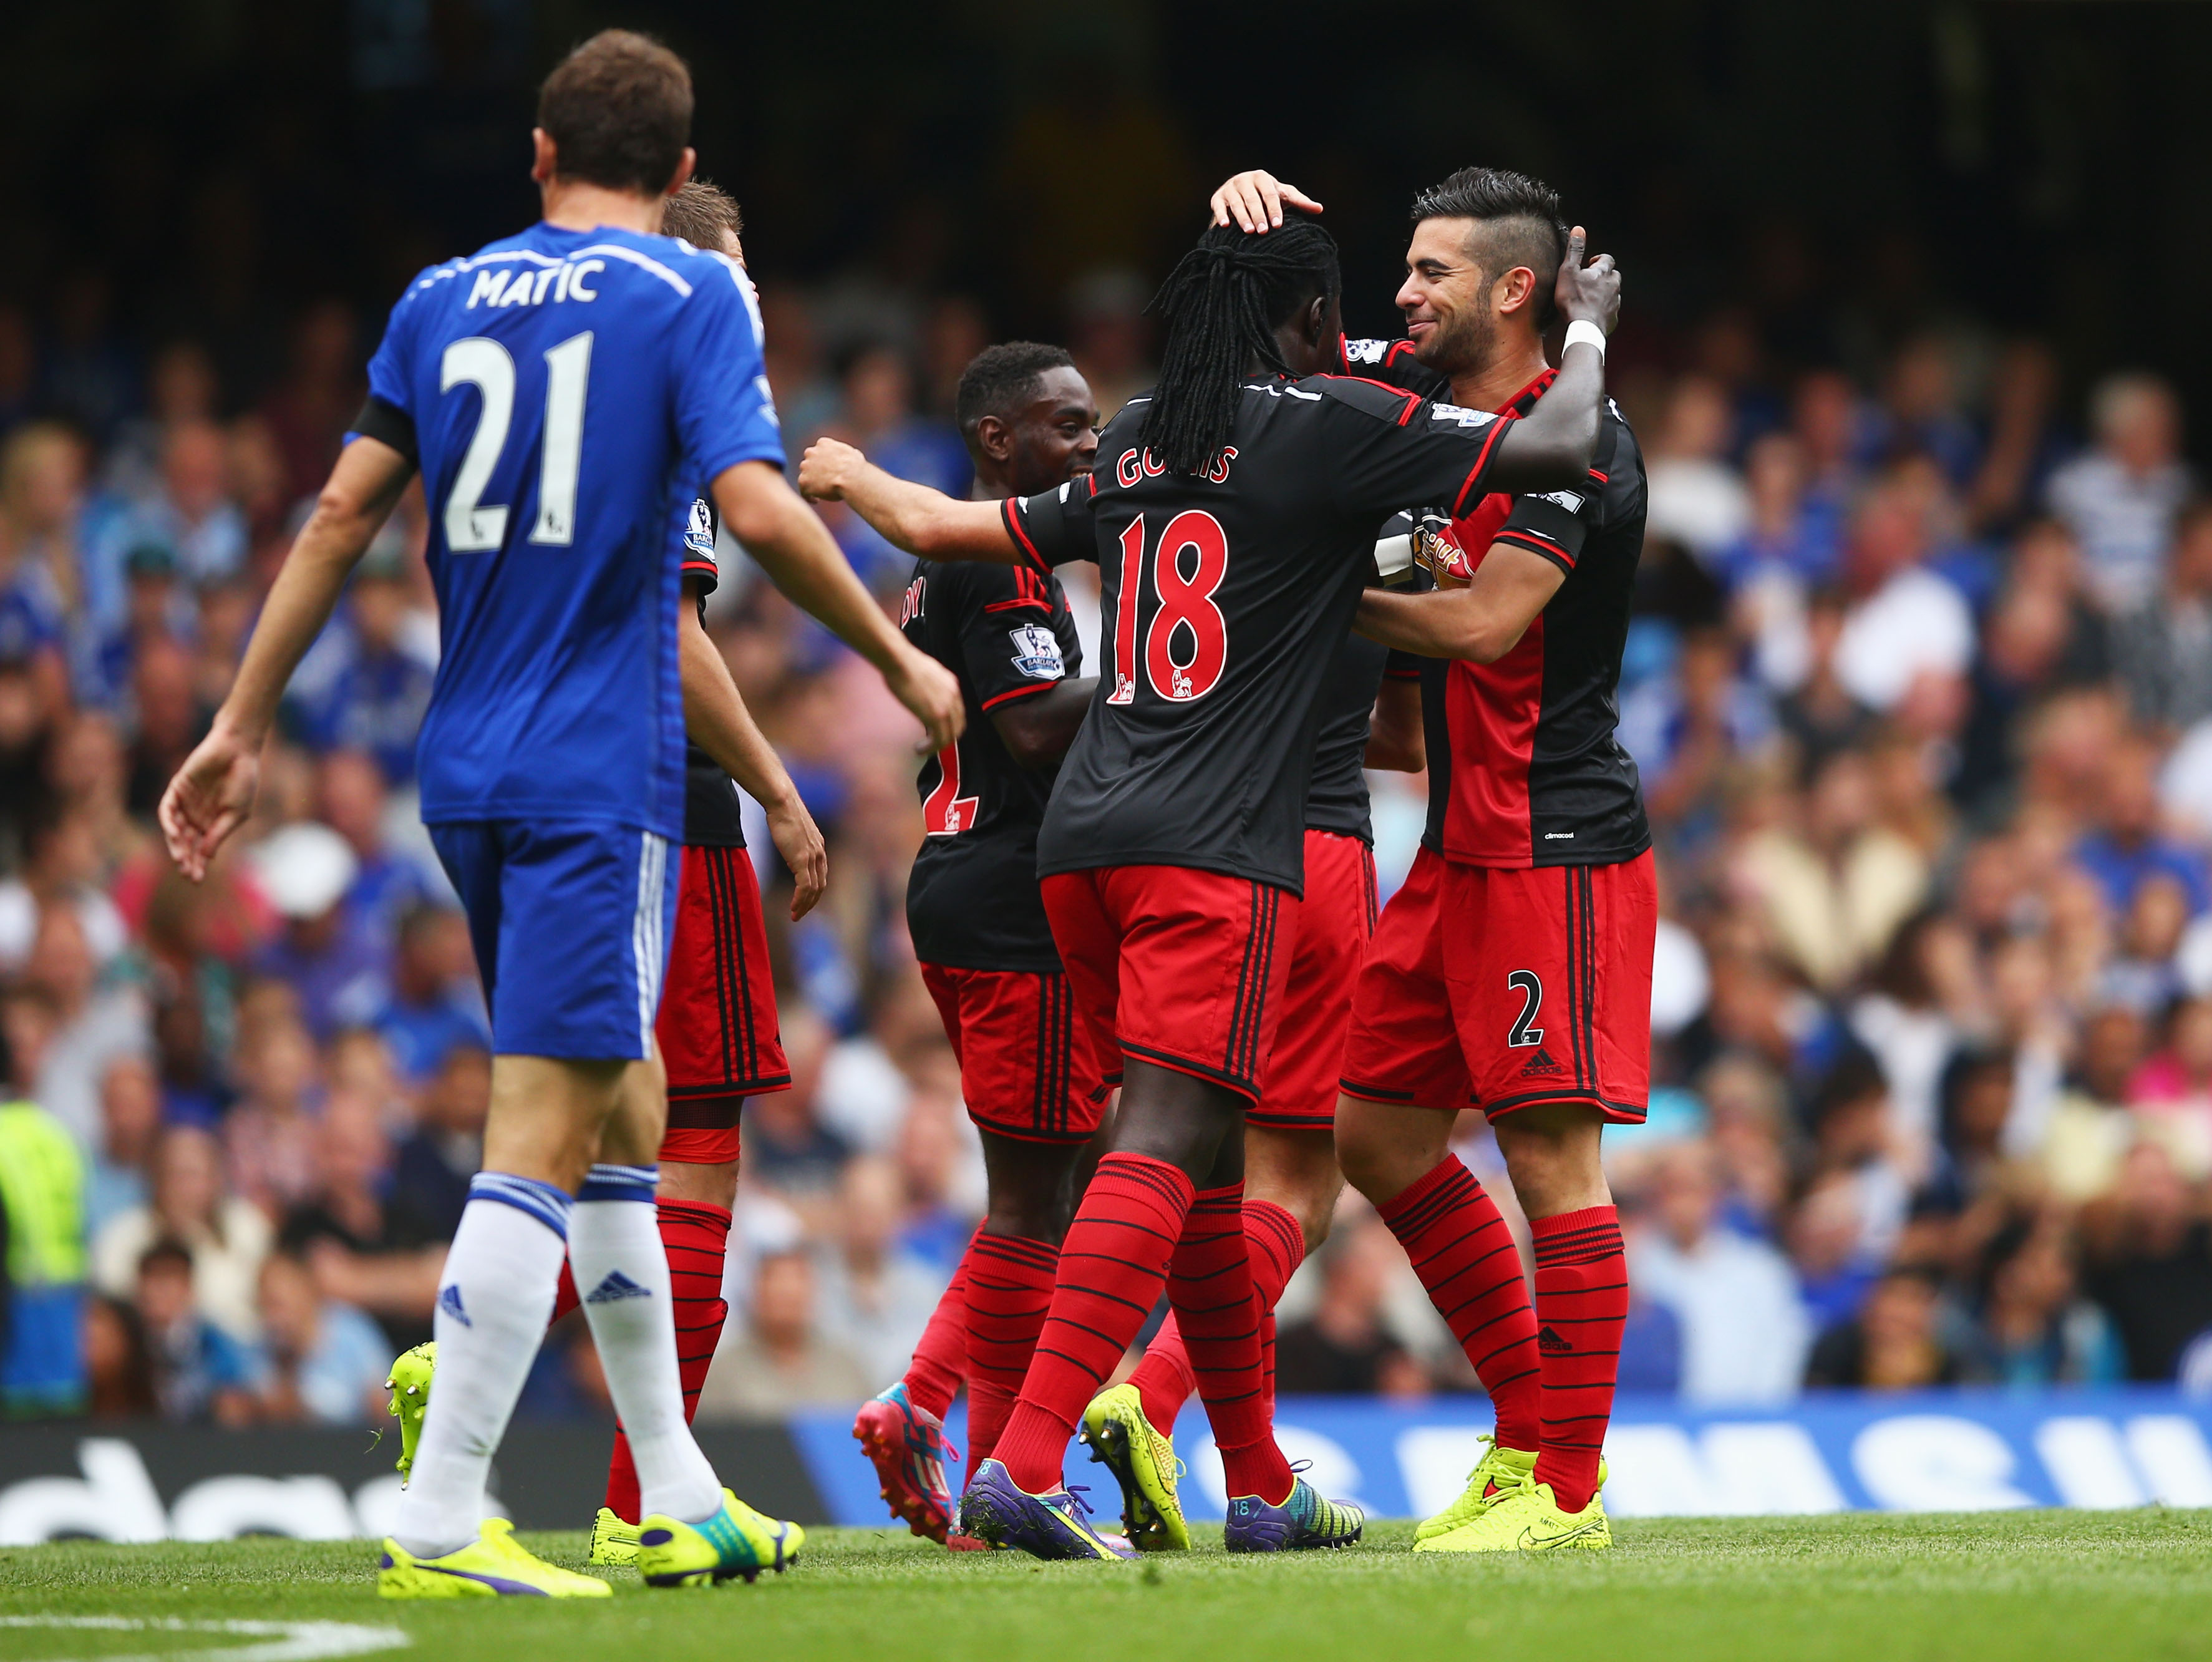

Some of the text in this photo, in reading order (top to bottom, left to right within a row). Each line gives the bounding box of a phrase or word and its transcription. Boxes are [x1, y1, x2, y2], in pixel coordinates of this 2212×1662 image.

[466, 259, 606, 309] MATIC
[440, 331, 593, 554] 21
[1116, 445, 1239, 488] GOIS
[1107, 510, 1228, 704] 18
[1545, 832, 1574, 840] climacool
[1508, 969, 1545, 1048] 2
[1521, 1066, 1562, 1077] adidas
[1233, 1500, 1250, 1516] 18
